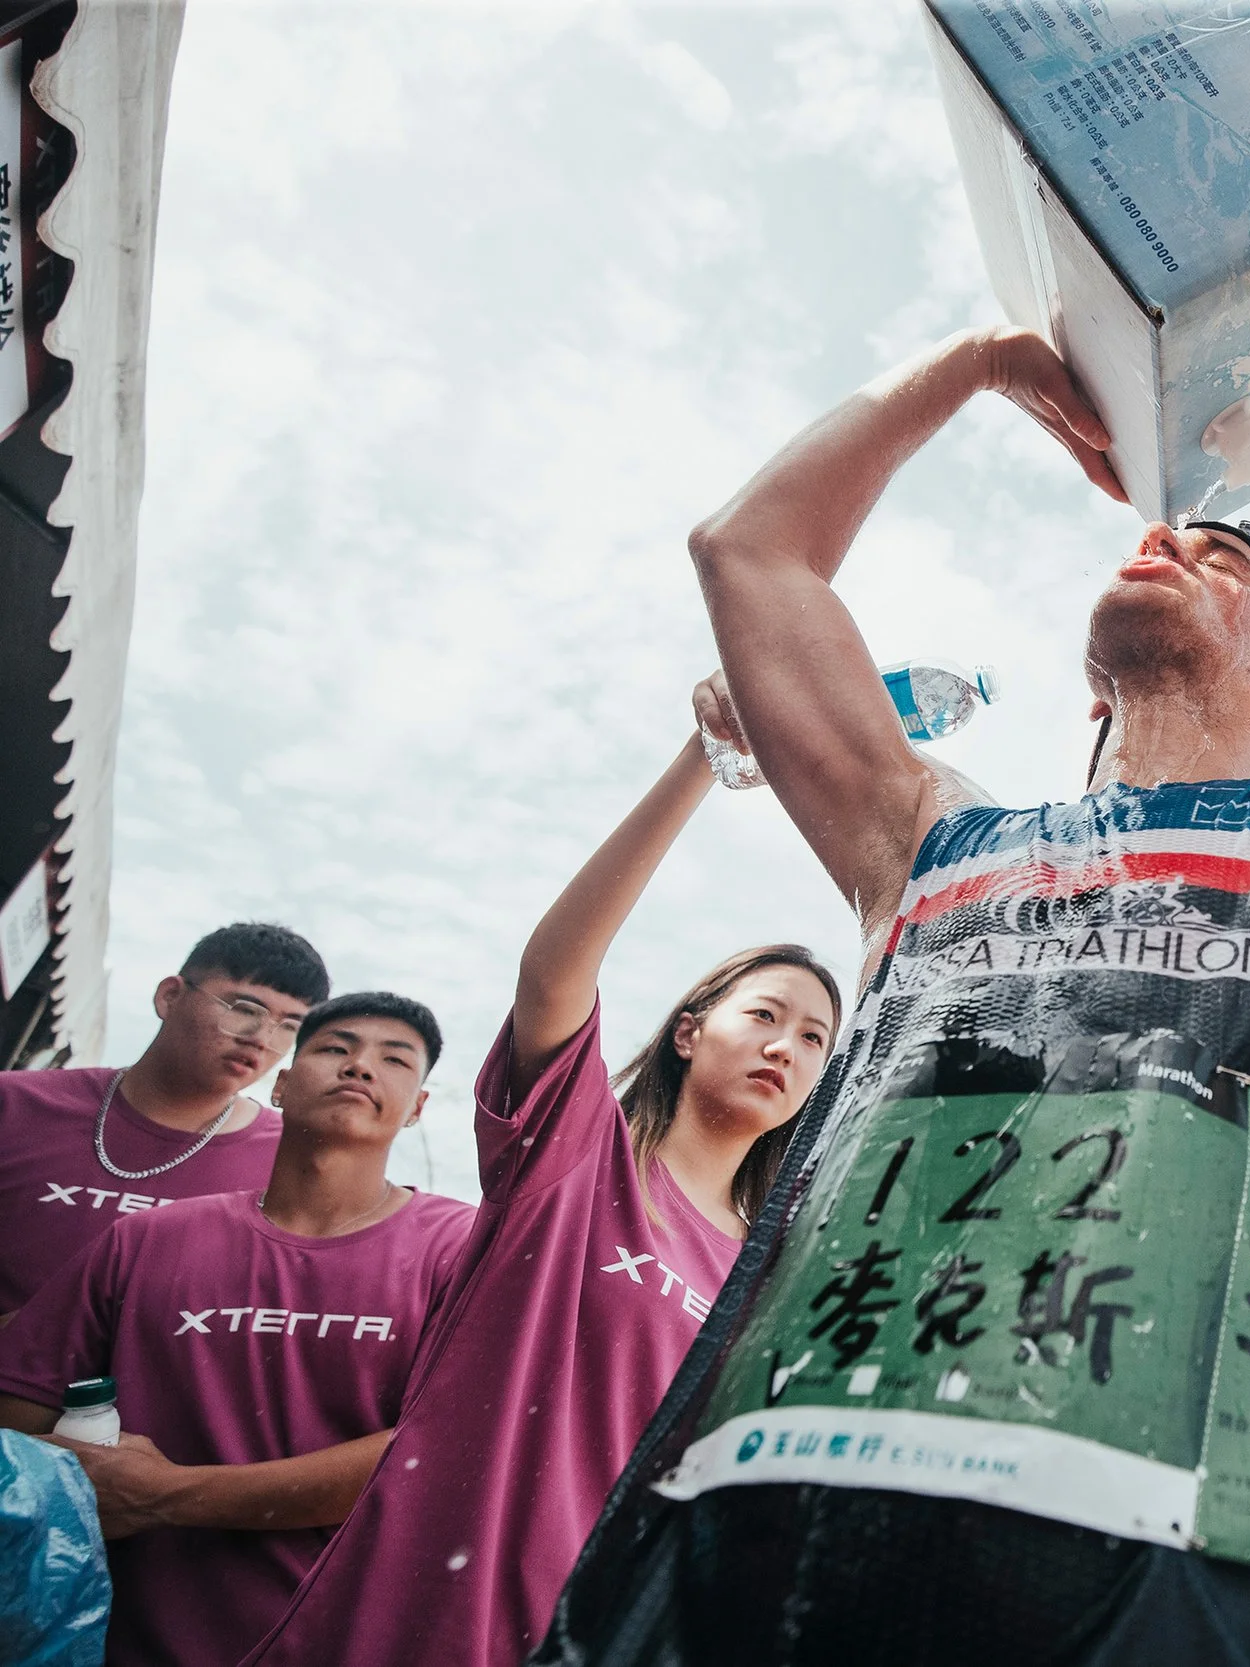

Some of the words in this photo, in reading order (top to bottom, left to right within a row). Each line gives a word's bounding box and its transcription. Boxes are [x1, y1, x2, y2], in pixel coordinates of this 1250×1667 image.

[1134, 218, 1158, 243] 080
[1151, 240, 1180, 273] 9000
[1137, 1061, 1214, 1102] Marathon
[174, 1307, 393, 1341] XTERRA
